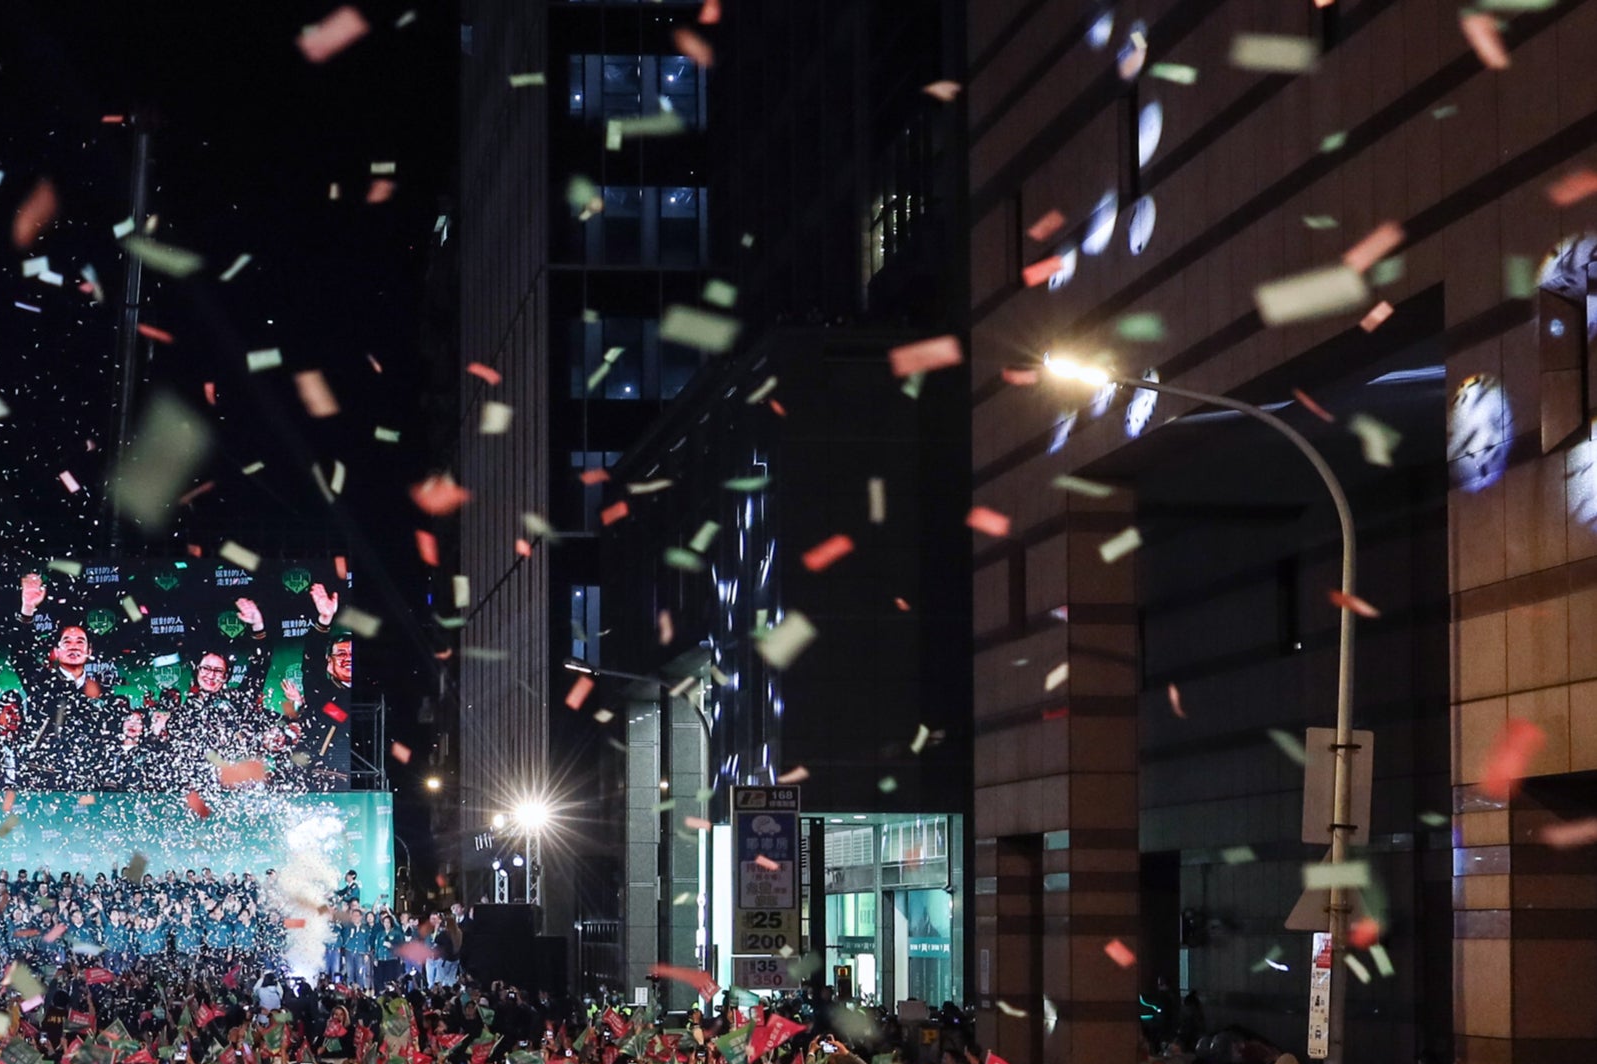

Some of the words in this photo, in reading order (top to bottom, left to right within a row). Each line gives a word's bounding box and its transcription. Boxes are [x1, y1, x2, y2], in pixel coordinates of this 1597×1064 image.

[151, 616, 183, 625] 選對的人
[35, 623, 52, 631] 的路
[283, 628, 308, 637] 走對的
[772, 791, 793, 800] 168
[753, 912, 782, 929] 25
[748, 934, 787, 950] 200
[757, 961, 777, 973] 35
[753, 974, 782, 986] 350
